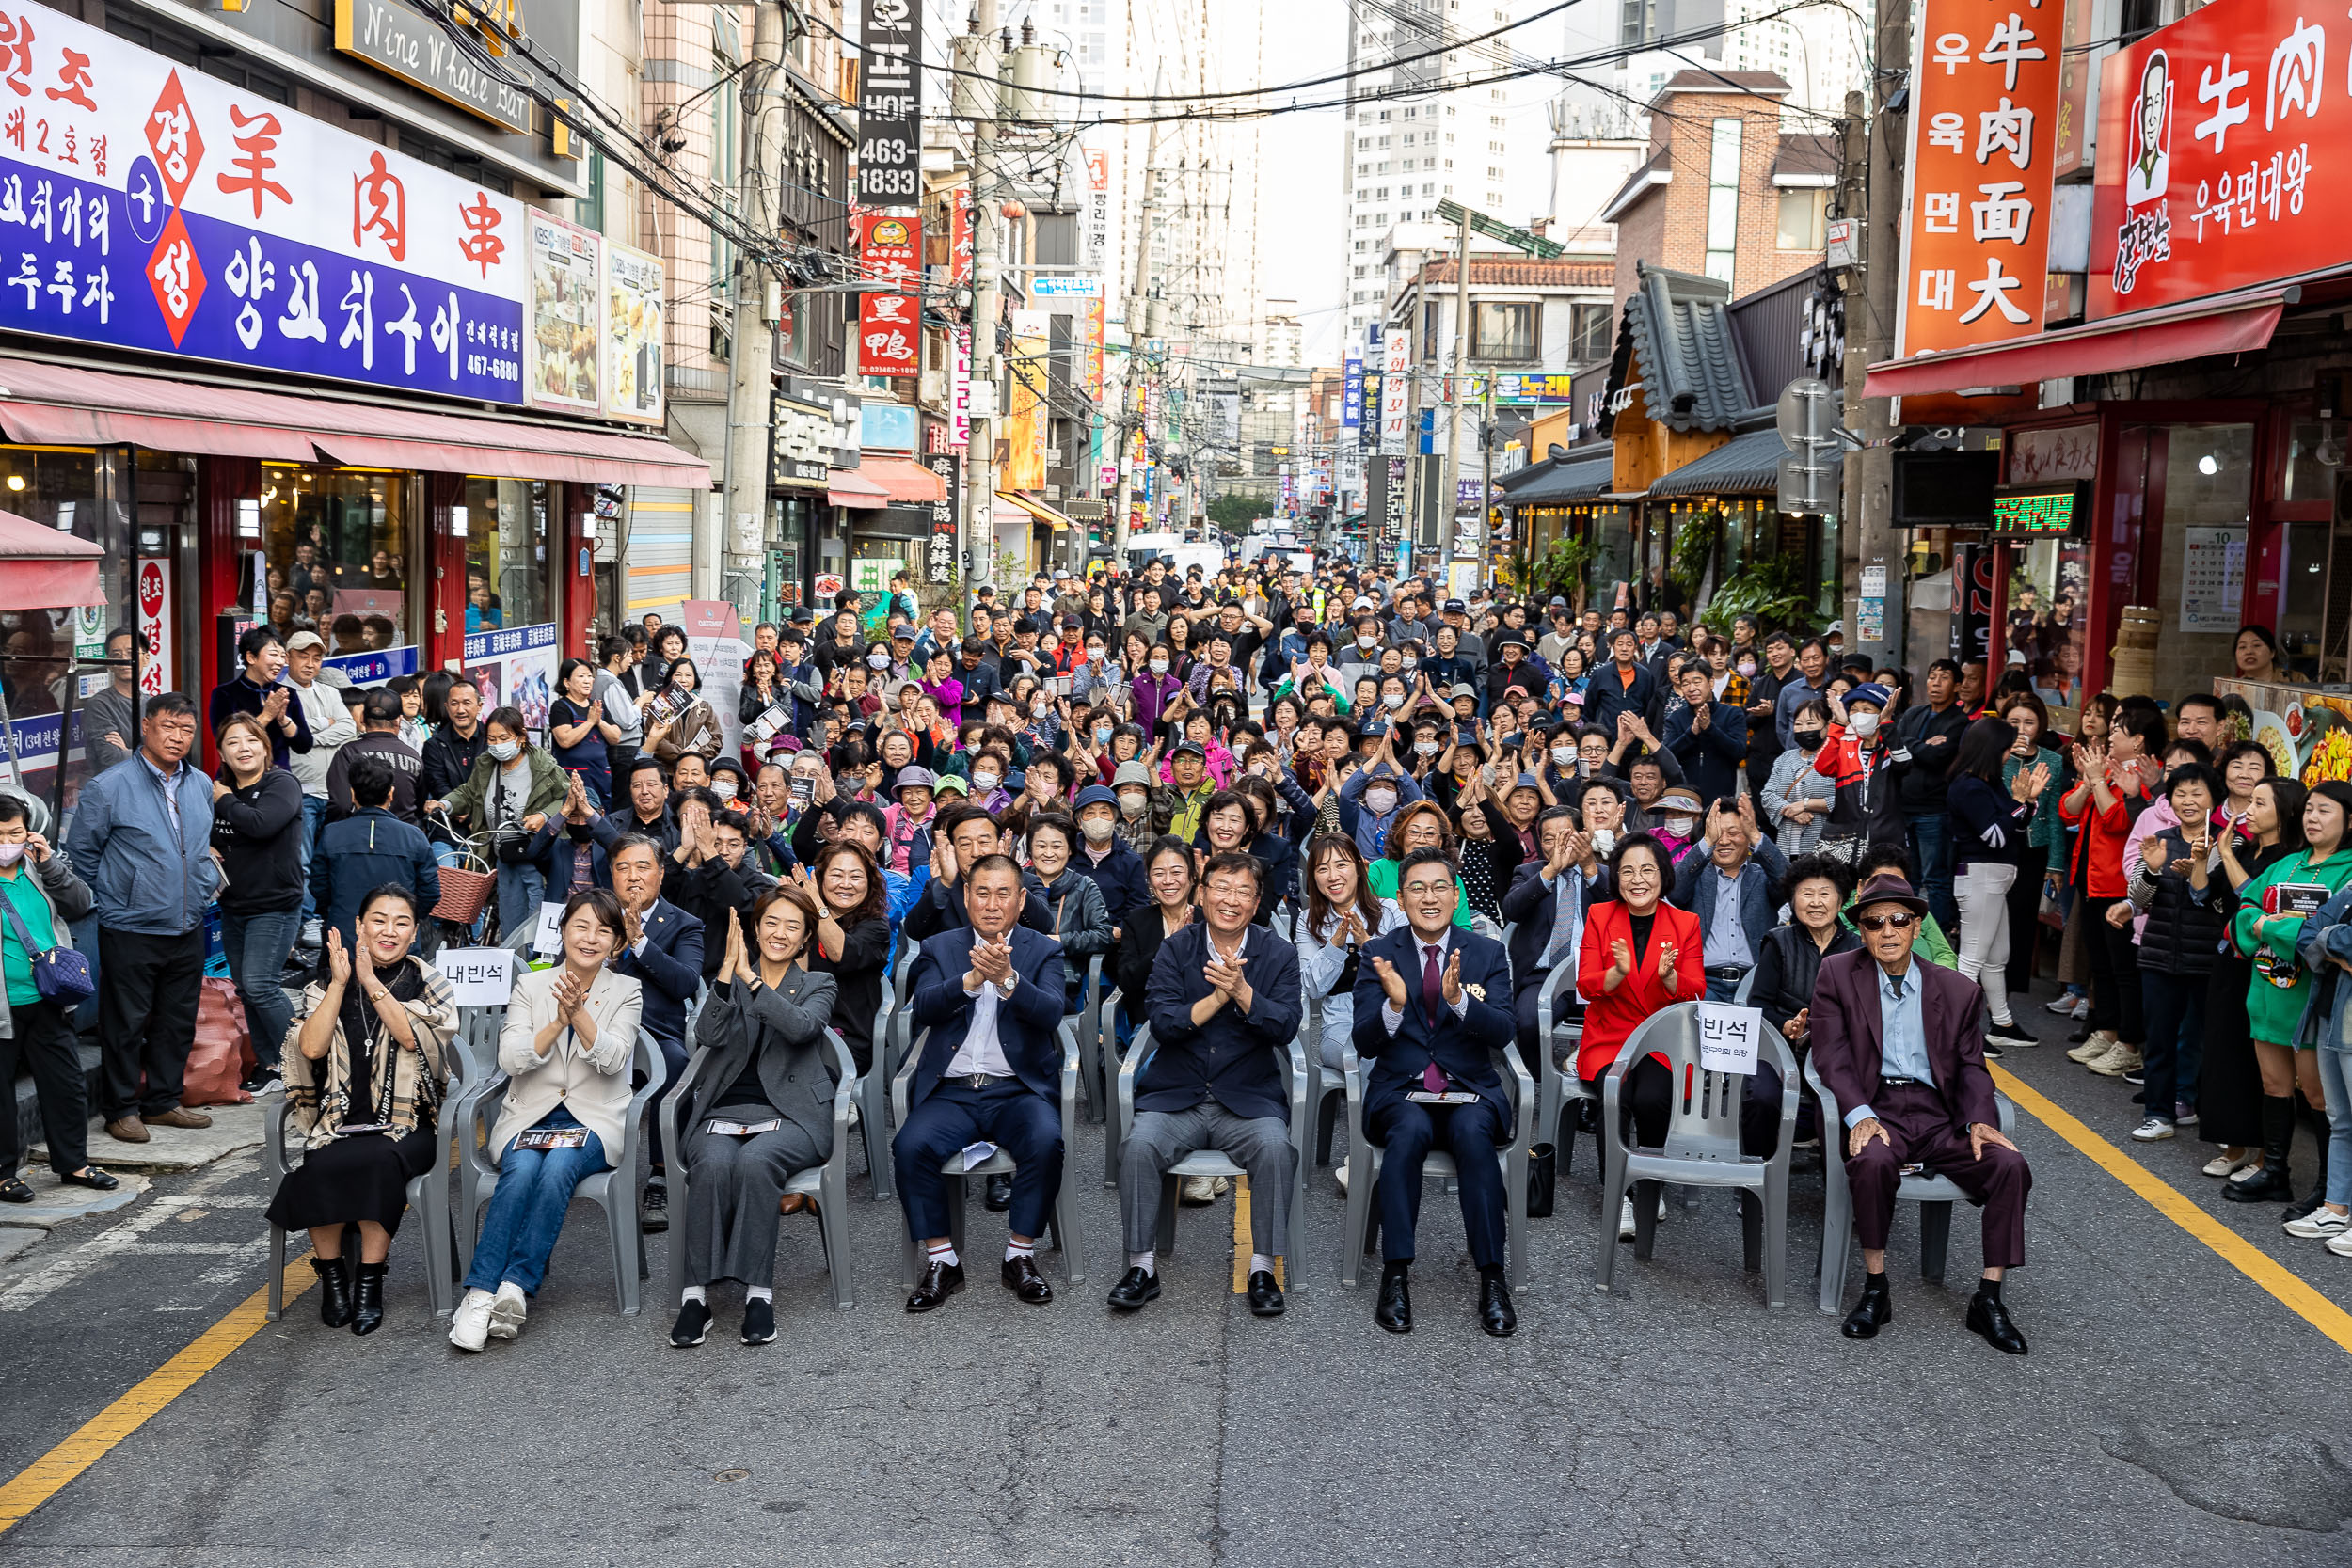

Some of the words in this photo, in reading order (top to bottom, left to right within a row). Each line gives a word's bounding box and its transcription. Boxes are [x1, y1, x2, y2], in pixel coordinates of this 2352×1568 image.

[364, 3, 420, 69] Nine
[428, 34, 489, 104] Whale
[496, 77, 526, 121] Bar
[2195, 16, 2352, 154] 牛肉
[865, 94, 914, 121] HOF
[860, 138, 918, 165] 463-
[217, 104, 505, 280] 羊肉串
[859, 168, 914, 195] 1833
[1915, 33, 1970, 356] 우육면대
[2190, 143, 2312, 244] 우육면대왕
[0, 251, 115, 325] 두주자
[225, 235, 459, 381] 양꼬치구이
[467, 354, 519, 382] 467-6880
[2215, 532, 2230, 545] 10
[141, 617, 162, 696] 경성
[464, 636, 486, 657] 羊肉串
[446, 964, 503, 984] 내빈석
[1699, 1016, 1748, 1043] 빈석
[1733, 1049, 1748, 1058] 의장
